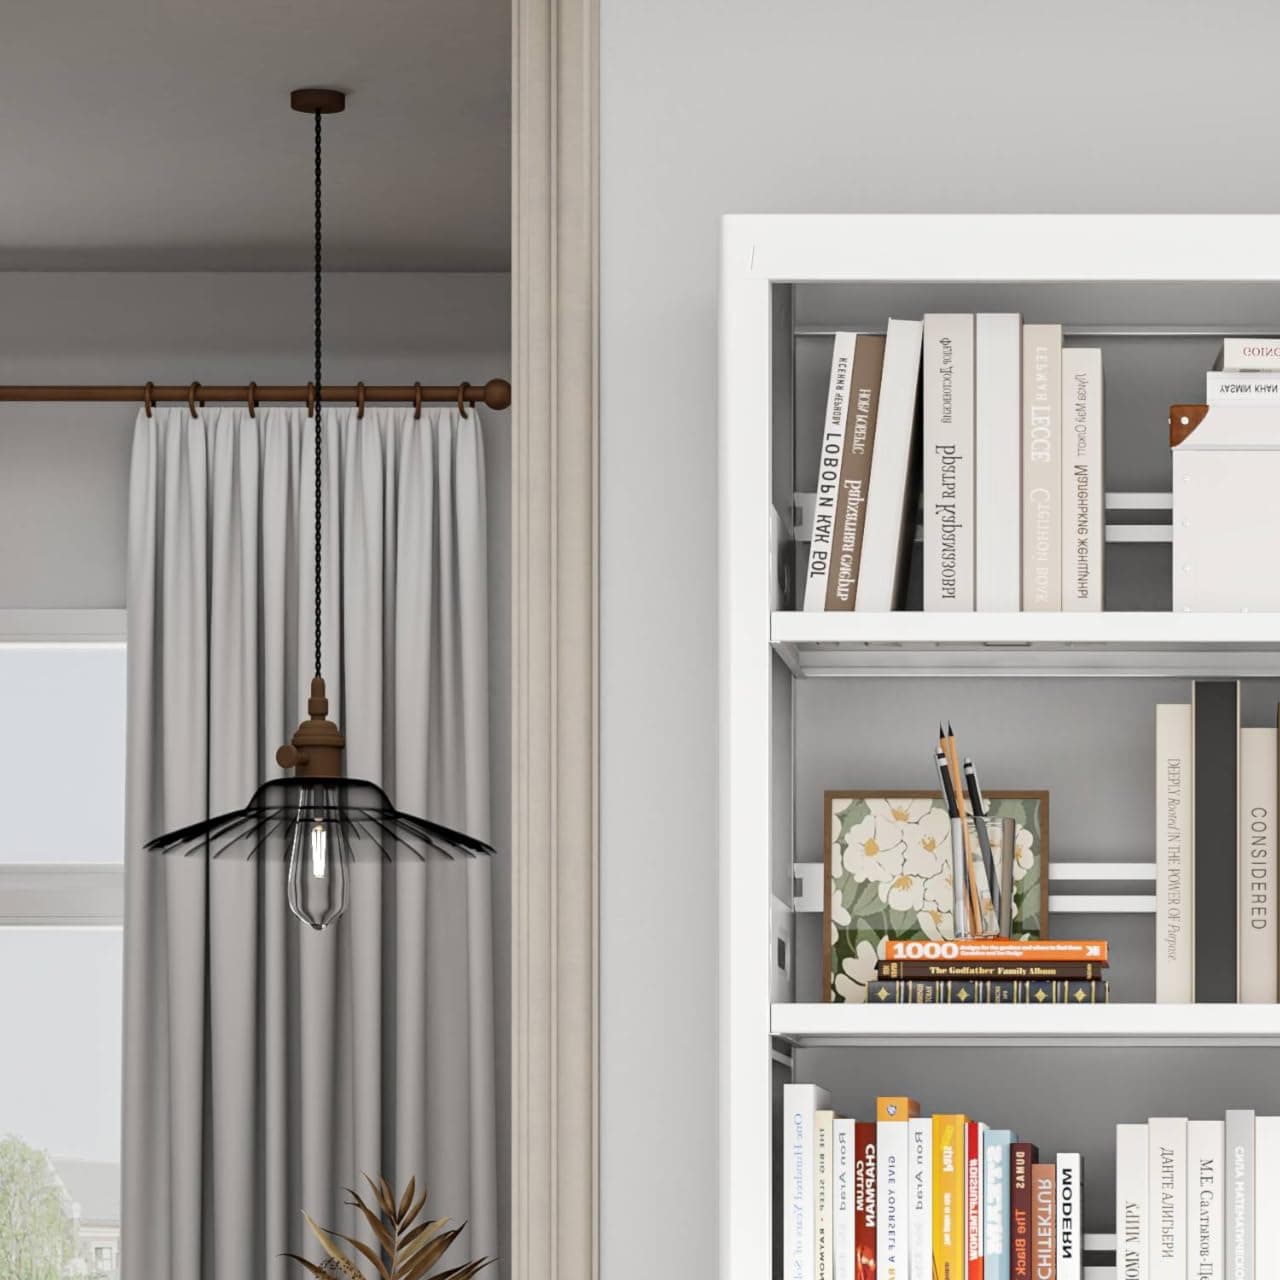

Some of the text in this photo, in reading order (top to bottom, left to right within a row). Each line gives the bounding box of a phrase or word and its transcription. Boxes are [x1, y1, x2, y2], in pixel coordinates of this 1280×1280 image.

[1251, 808, 1267, 930] CONSIDERED
[893, 942, 959, 959] 1000
[949, 966, 995, 975] Godfather
[997, 967, 1027, 976] Family
[1029, 967, 1056, 975] Album
[1234, 1146, 1243, 1178] СИЛА
[1160, 1147, 1174, 1258] ДАНТЕ АЛИГЬЕРИ
